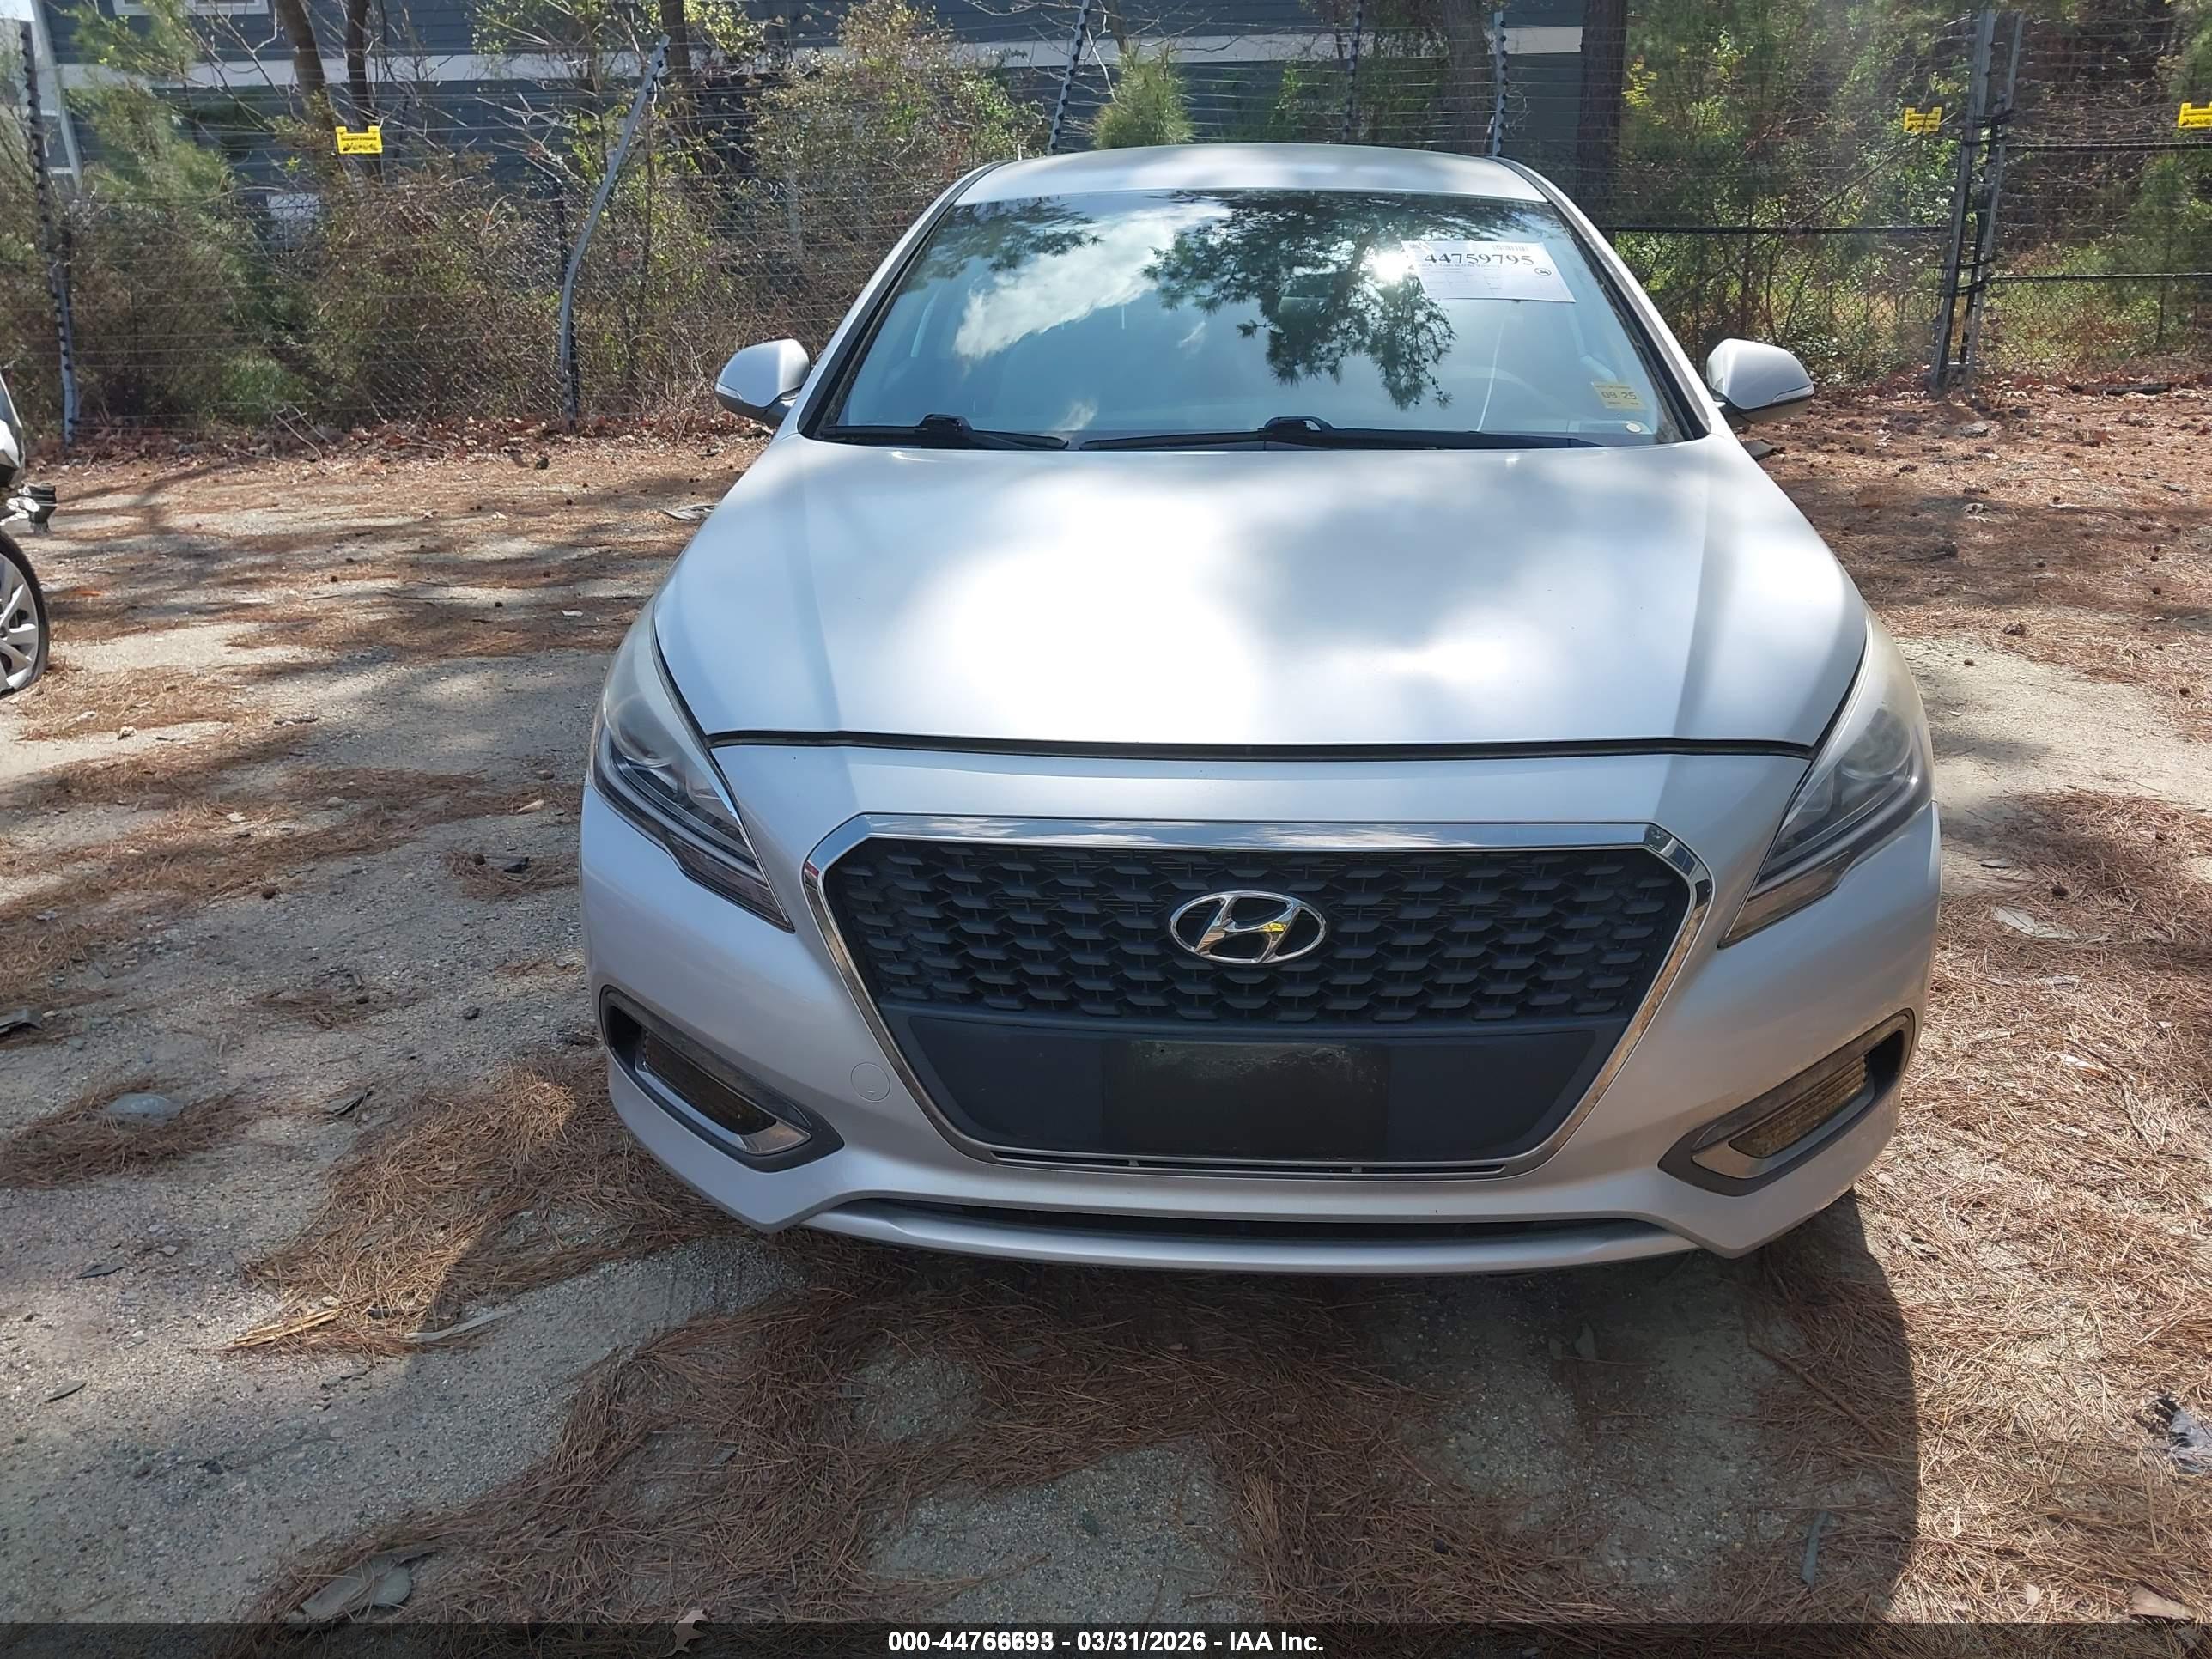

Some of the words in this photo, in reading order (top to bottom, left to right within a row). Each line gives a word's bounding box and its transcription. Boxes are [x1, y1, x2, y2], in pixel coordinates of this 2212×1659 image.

[1425, 252, 1534, 266] 44759795
[1601, 391, 1619, 399] 09
[1620, 392, 1638, 400] 25
